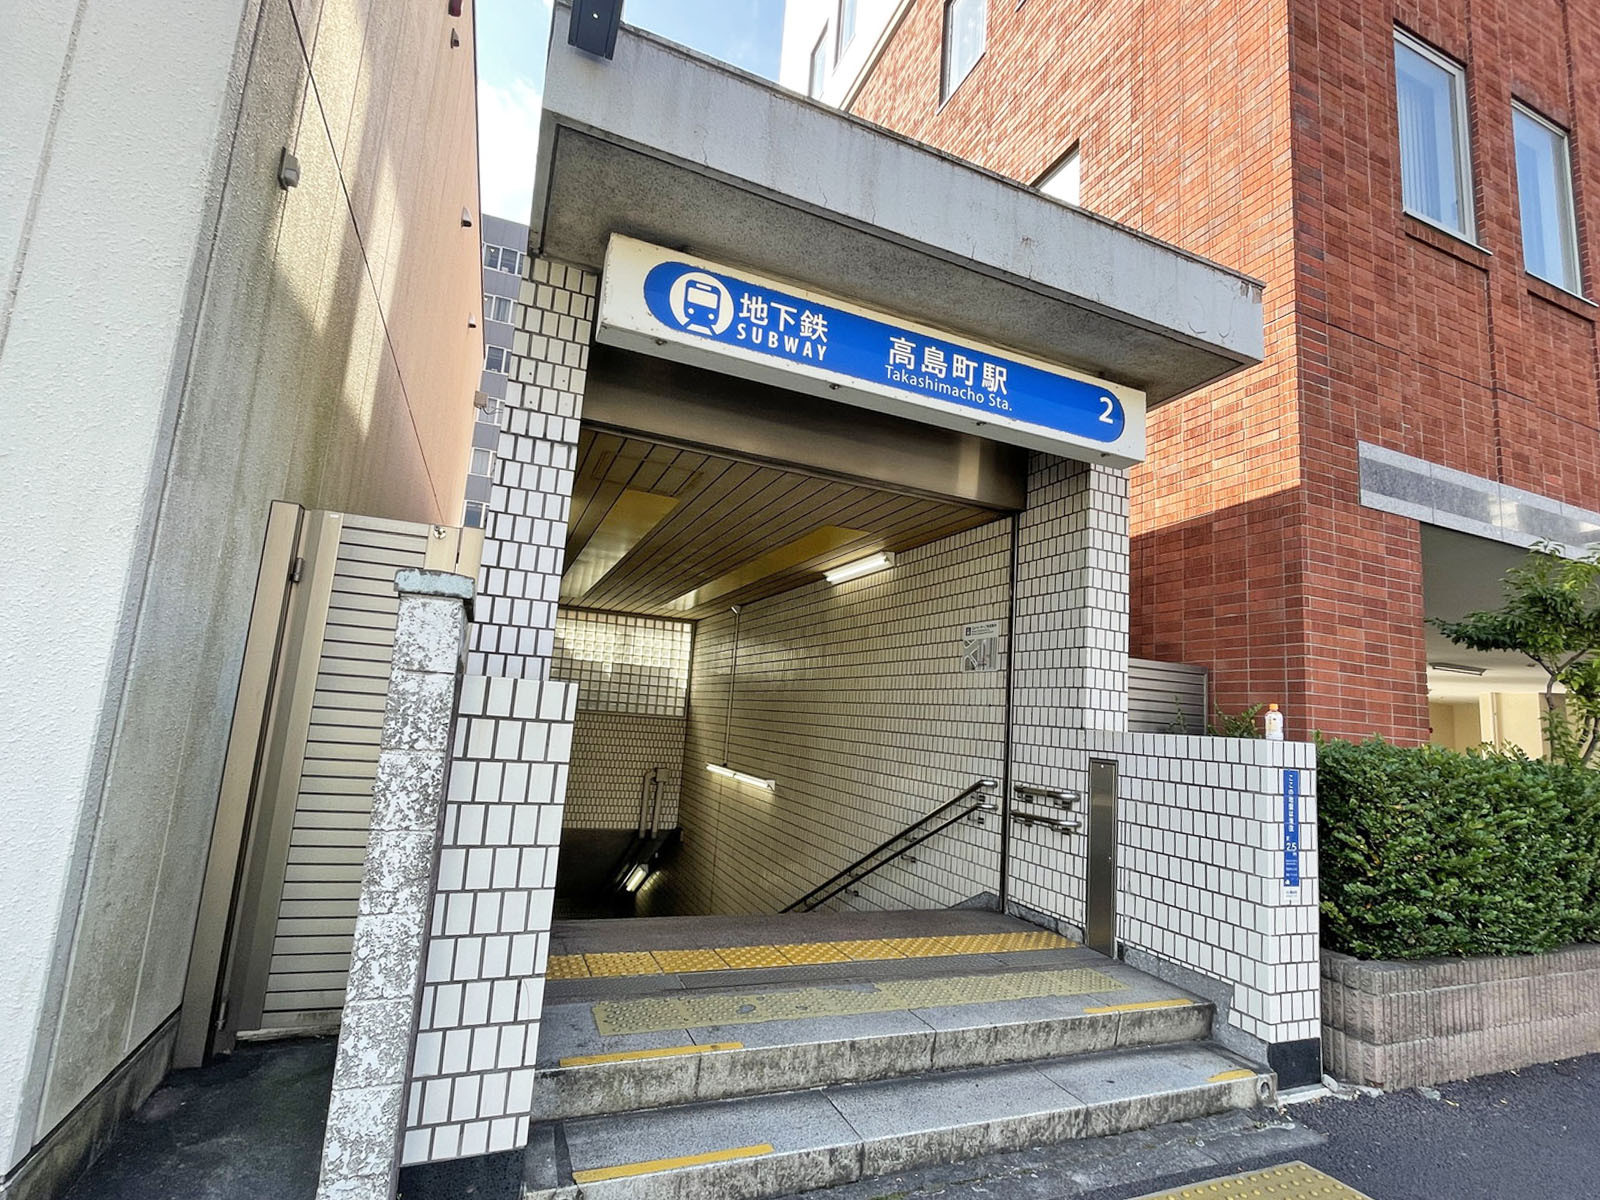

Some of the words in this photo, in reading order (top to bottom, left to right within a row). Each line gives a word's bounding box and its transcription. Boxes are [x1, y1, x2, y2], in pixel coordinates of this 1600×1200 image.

[738, 292, 828, 343] 地下鉄
[736, 322, 827, 361] SUBWAY
[885, 364, 985, 404] Takashimacho
[988, 393, 1013, 411] Sta.
[888, 337, 1008, 395] 高島町駅
[1099, 396, 1114, 424] 2
